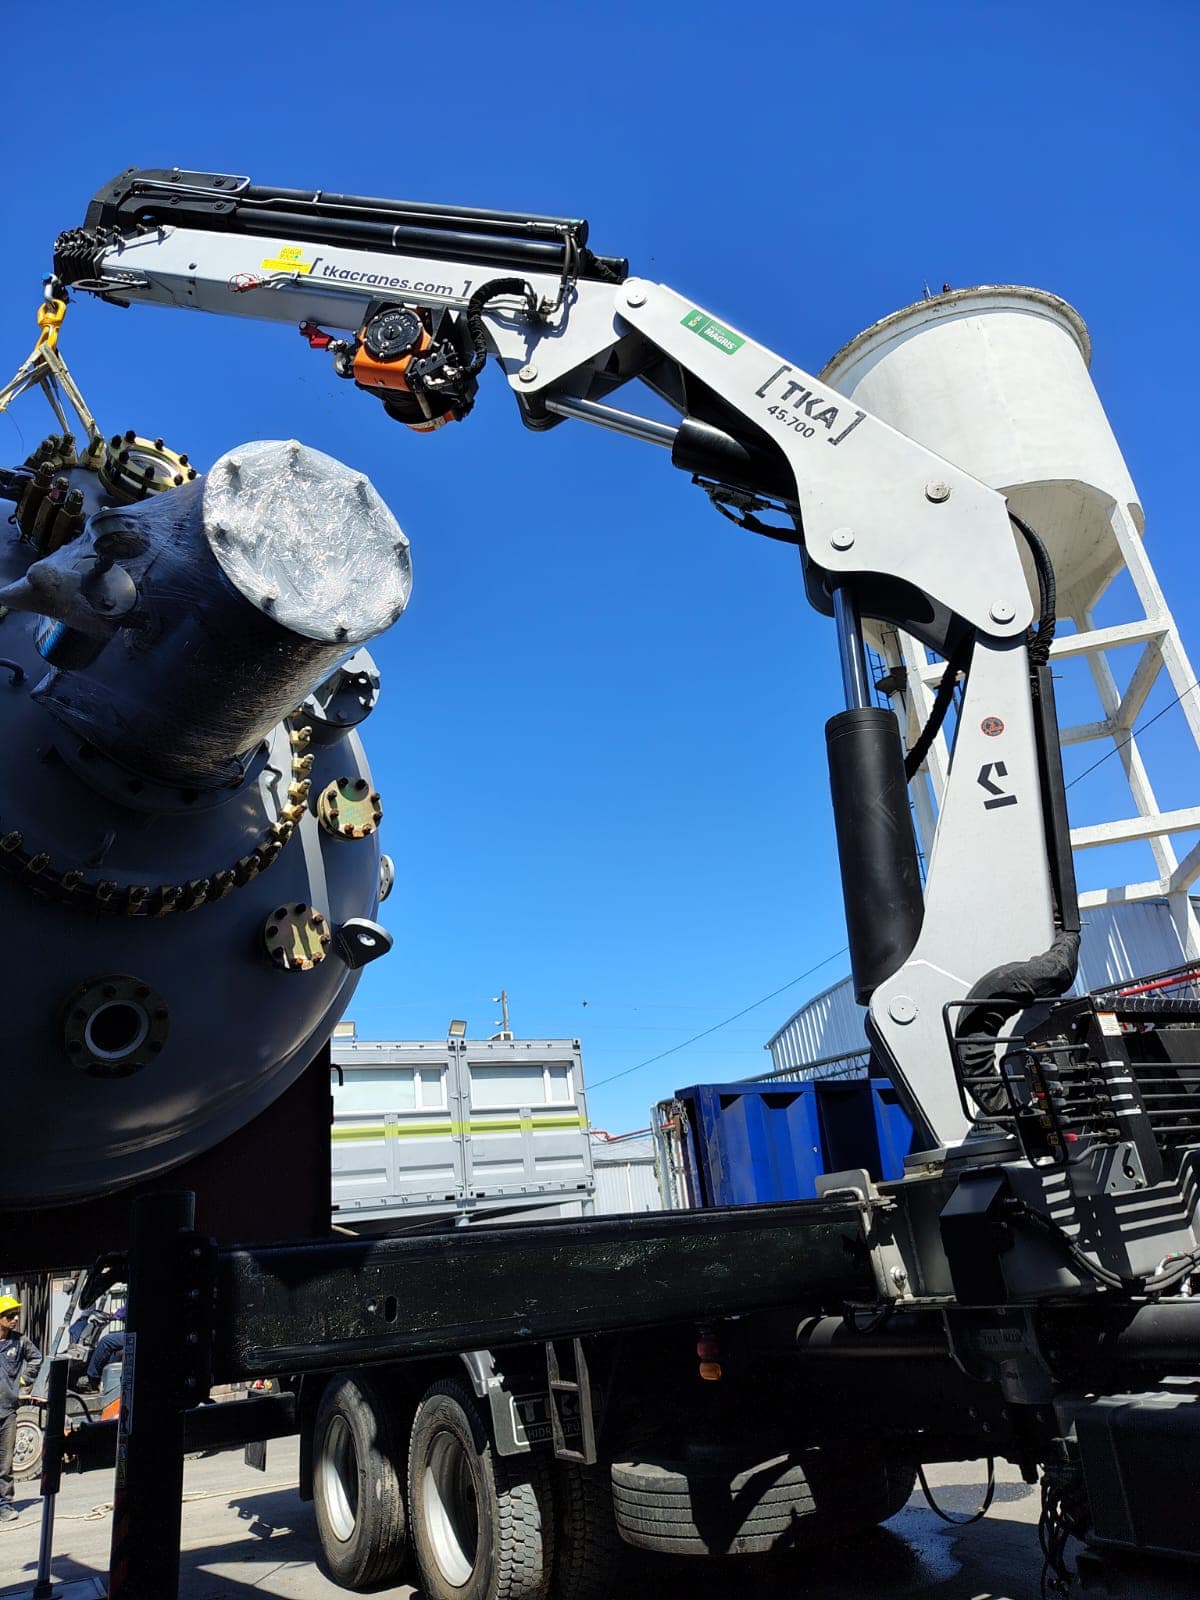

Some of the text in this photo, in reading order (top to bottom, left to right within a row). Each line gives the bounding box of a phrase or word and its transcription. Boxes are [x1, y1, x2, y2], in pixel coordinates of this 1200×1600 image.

[322, 264, 454, 295] tkacranes.com
[704, 327, 736, 350] MAGRIS
[766, 404, 816, 439] 45.700
